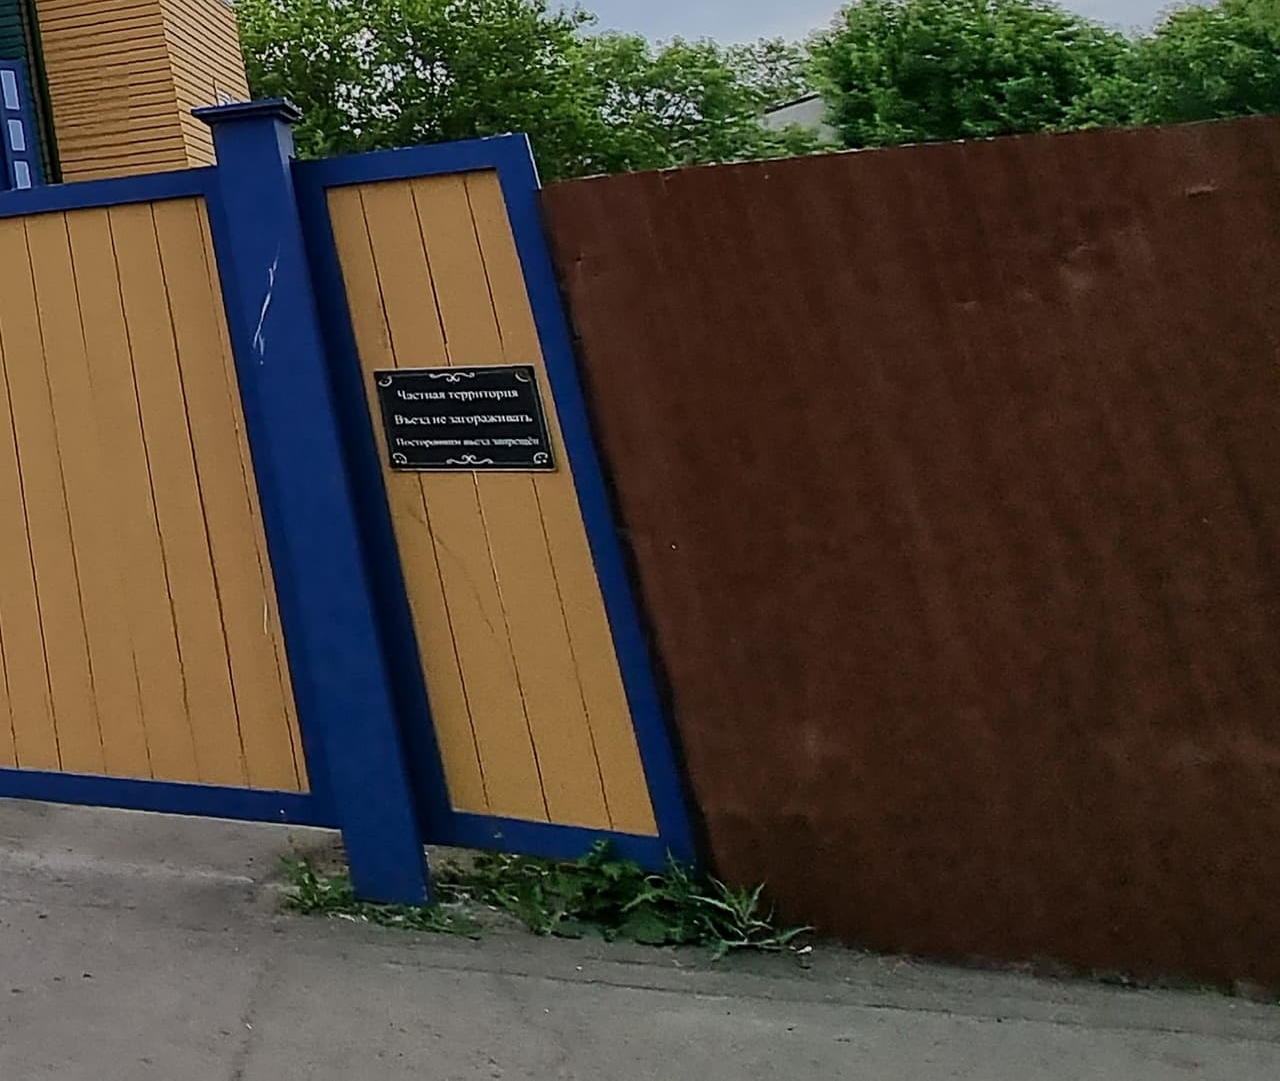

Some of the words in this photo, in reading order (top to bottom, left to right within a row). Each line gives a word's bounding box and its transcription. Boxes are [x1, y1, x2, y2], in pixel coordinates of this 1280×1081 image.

[397, 389, 446, 401] Частная
[448, 389, 519, 402] территория
[394, 414, 430, 426] Въезд
[432, 415, 447, 425] не
